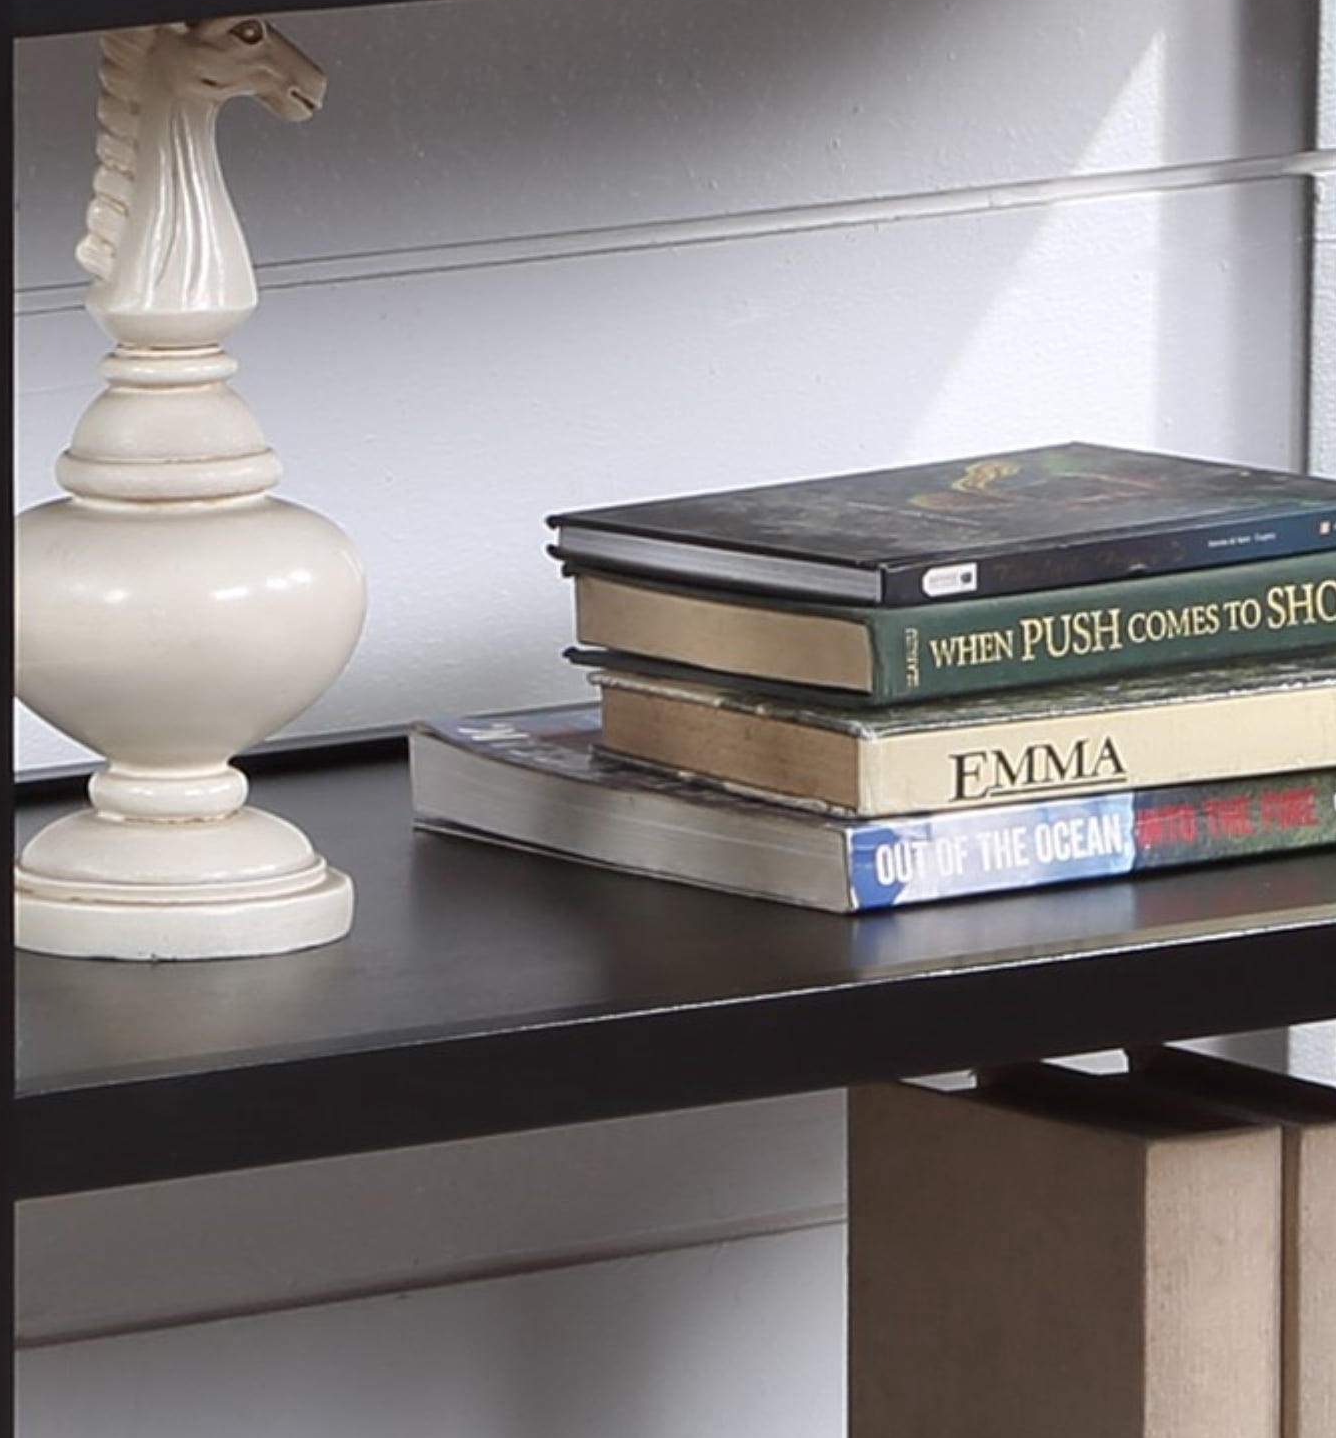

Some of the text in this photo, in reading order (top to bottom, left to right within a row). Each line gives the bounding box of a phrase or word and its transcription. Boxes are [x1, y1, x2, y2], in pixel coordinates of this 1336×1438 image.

[929, 630, 1014, 668] WHEN
[1021, 608, 1122, 660] PUSH
[1127, 603, 1220, 644] COMES
[1222, 594, 1262, 631] TO
[949, 738, 1126, 801] EMMA
[1204, 794, 1252, 839] THE
[1259, 787, 1320, 832] FIRE
[875, 814, 1131, 886] OUT OF THE OCEAN,
